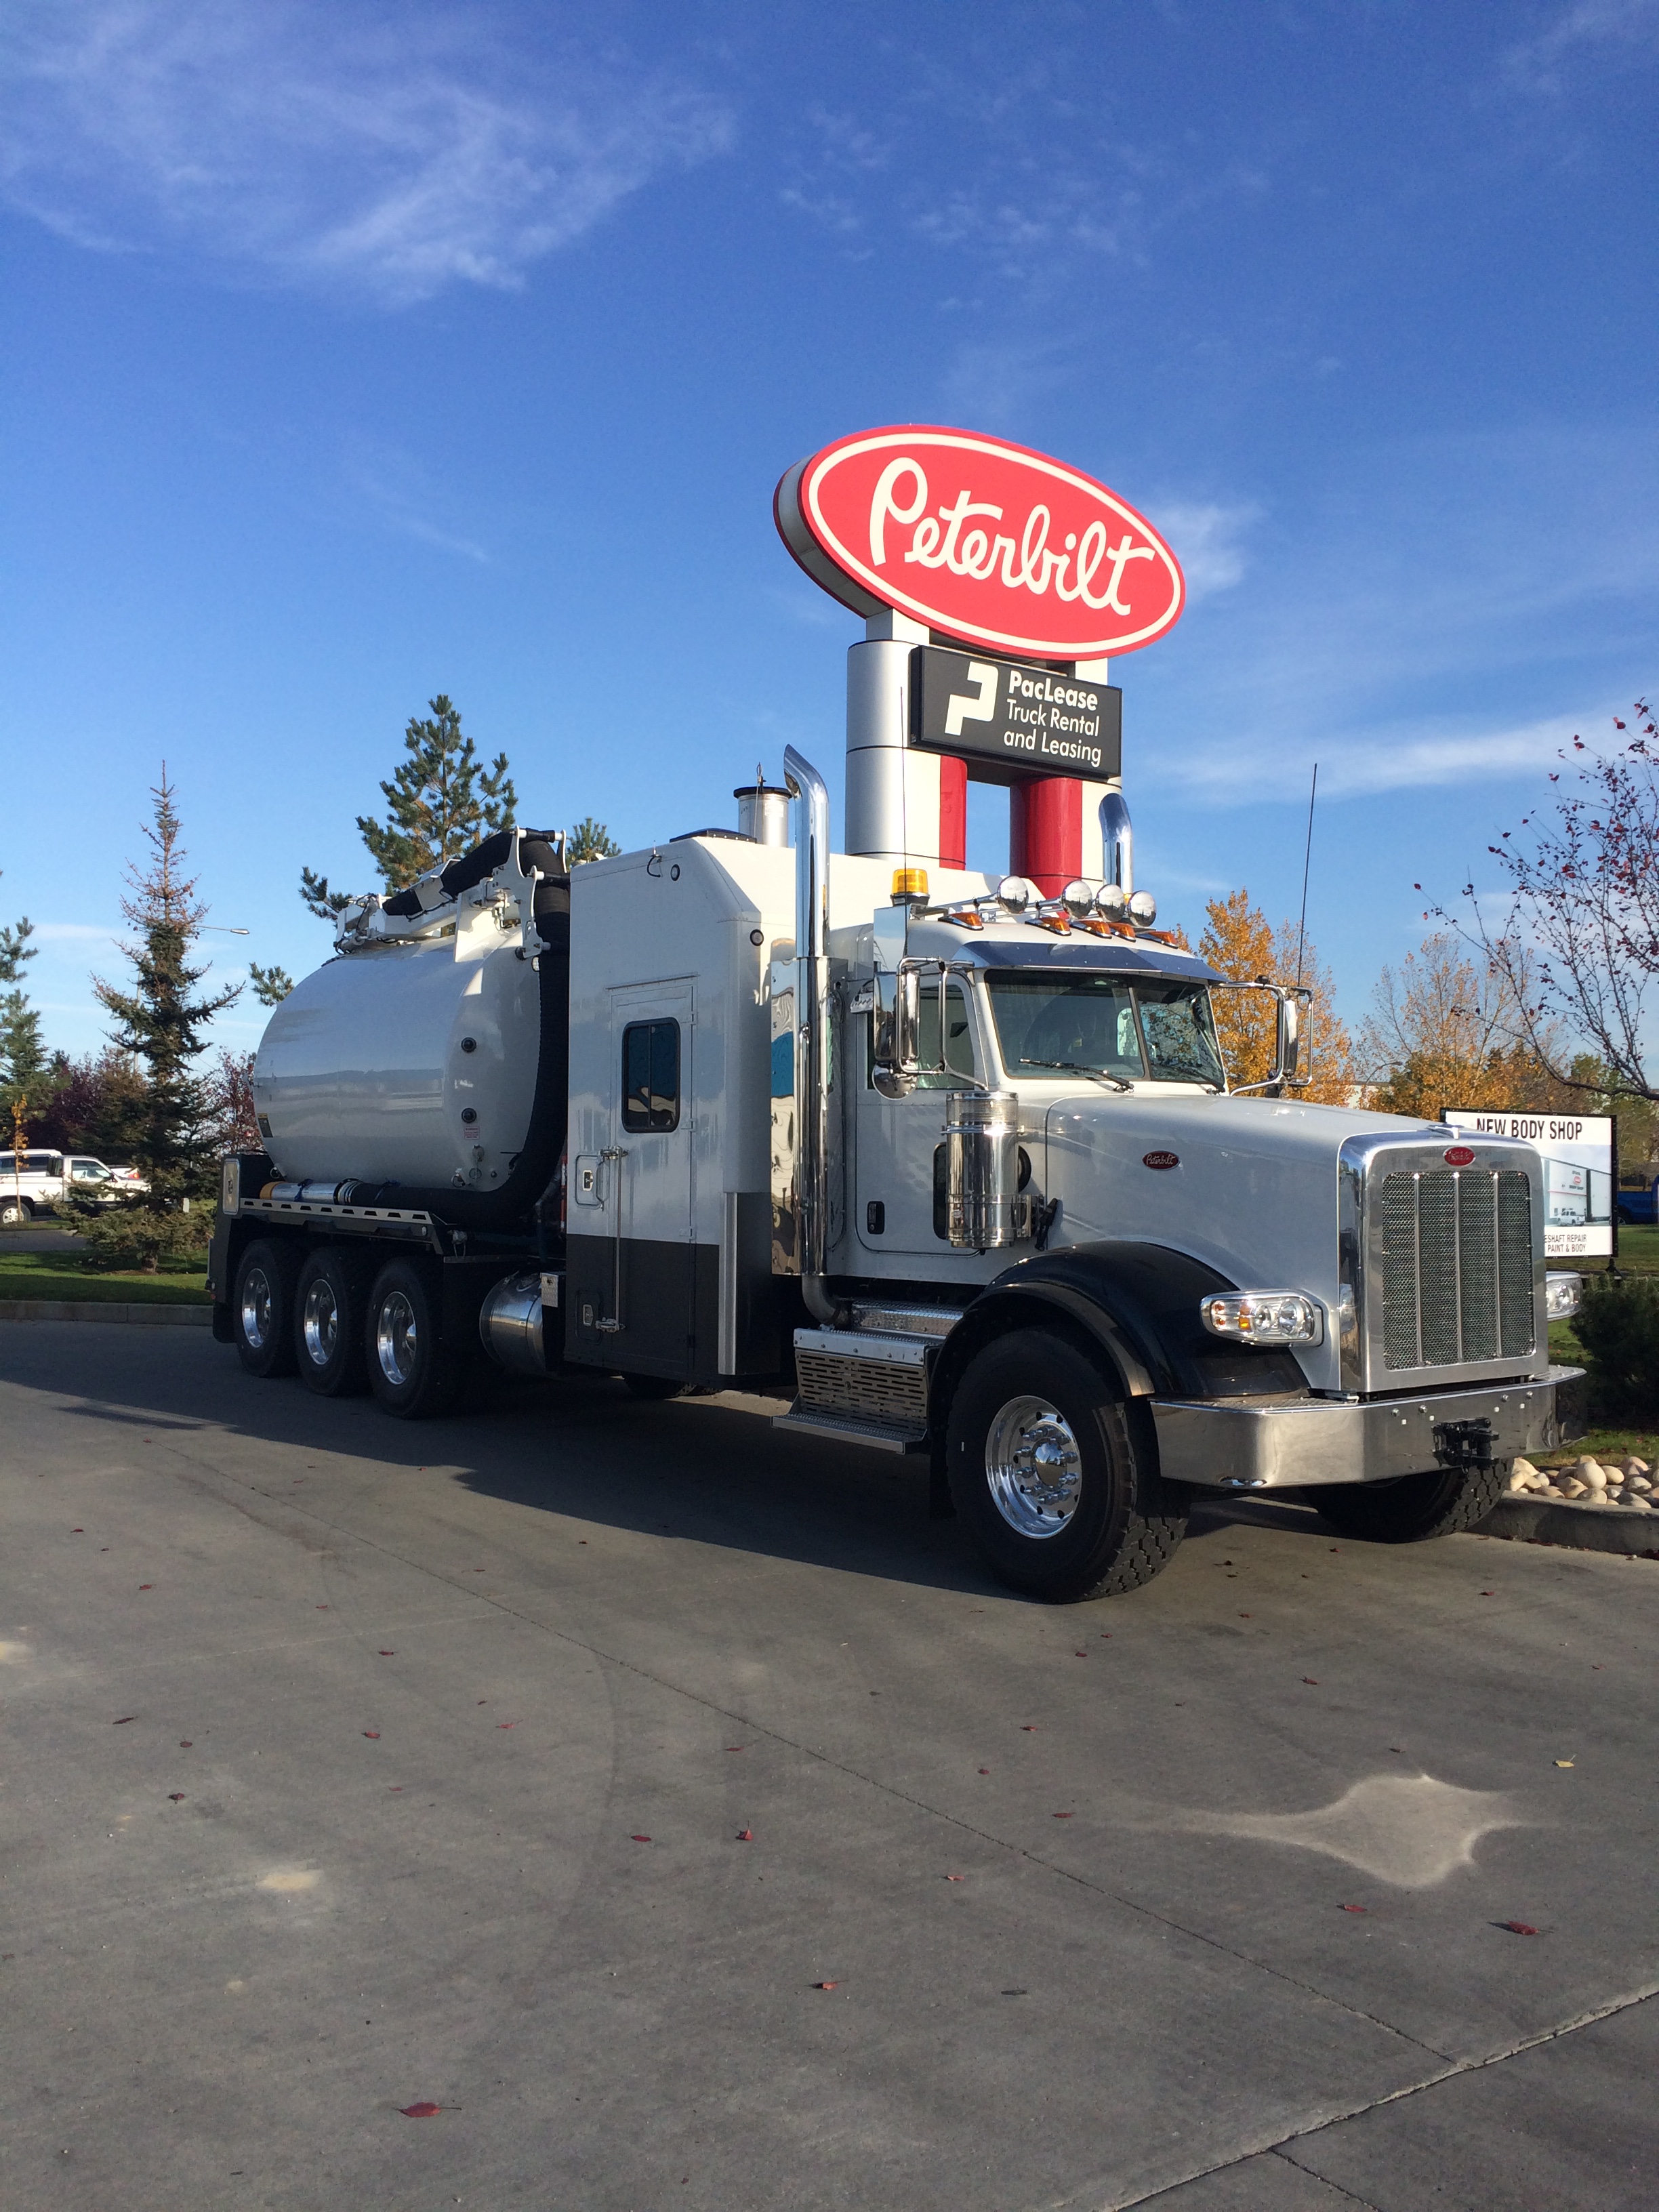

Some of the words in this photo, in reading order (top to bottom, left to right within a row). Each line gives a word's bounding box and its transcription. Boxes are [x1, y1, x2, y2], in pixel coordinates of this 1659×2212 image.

[869, 457, 1155, 616] Peterbilt
[1008, 670, 1098, 711] PacLease
[1006, 698, 1047, 726] Truck
[1050, 707, 1100, 737] Rental
[1004, 729, 1037, 750] and
[1041, 731, 1102, 768] Leasing
[1477, 1118, 1507, 1135] NEW
[1511, 1119, 1545, 1139] BODY
[1549, 1120, 1582, 1141] SHOP
[1547, 1244, 1564, 1252] PAINT
[1565, 1244, 1570, 1252] &
[1572, 1244, 1586, 1252] BODY
[1567, 1233, 1587, 1243] REPAIR
